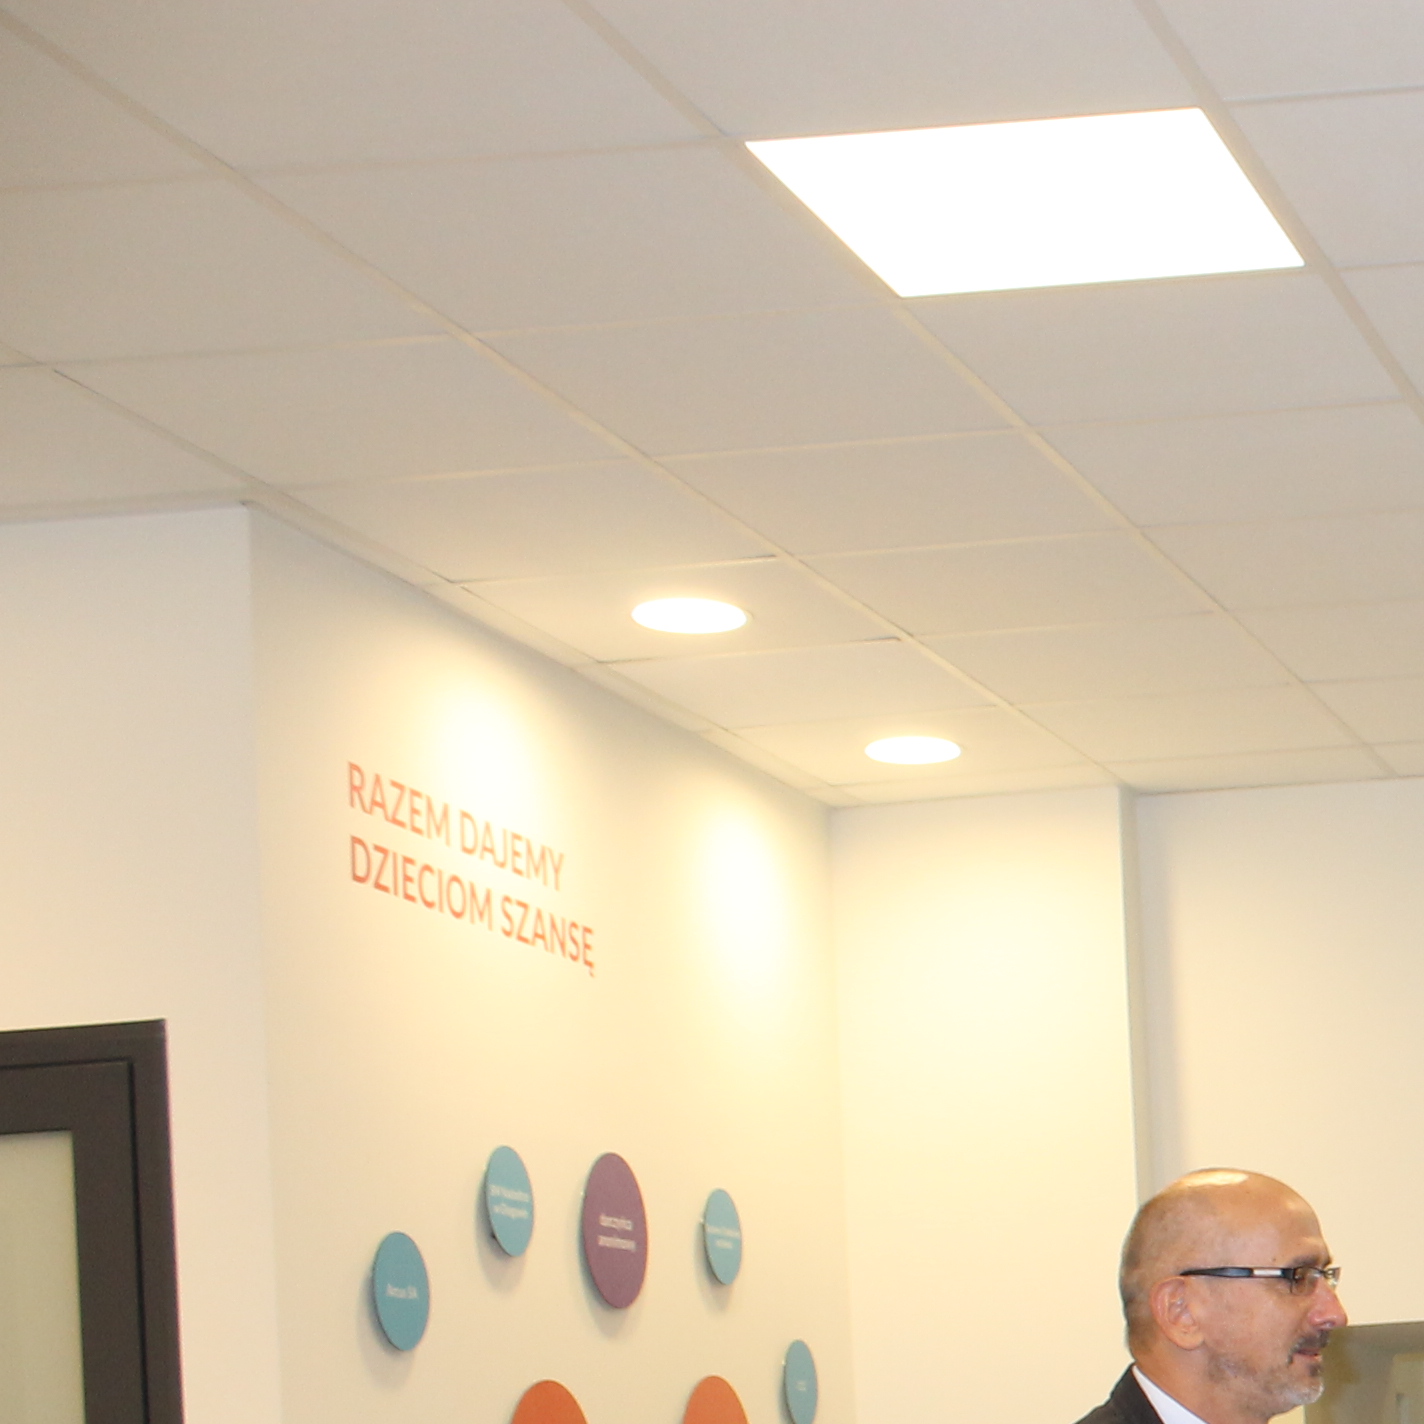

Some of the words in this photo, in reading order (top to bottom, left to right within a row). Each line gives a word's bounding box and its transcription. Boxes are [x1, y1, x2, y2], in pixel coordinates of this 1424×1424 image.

[348, 761, 452, 848] RAZEM
[459, 808, 566, 893] DAJEMY
[350, 834, 494, 933] DZIECIOM
[501, 894, 596, 979] SZANSĘ
